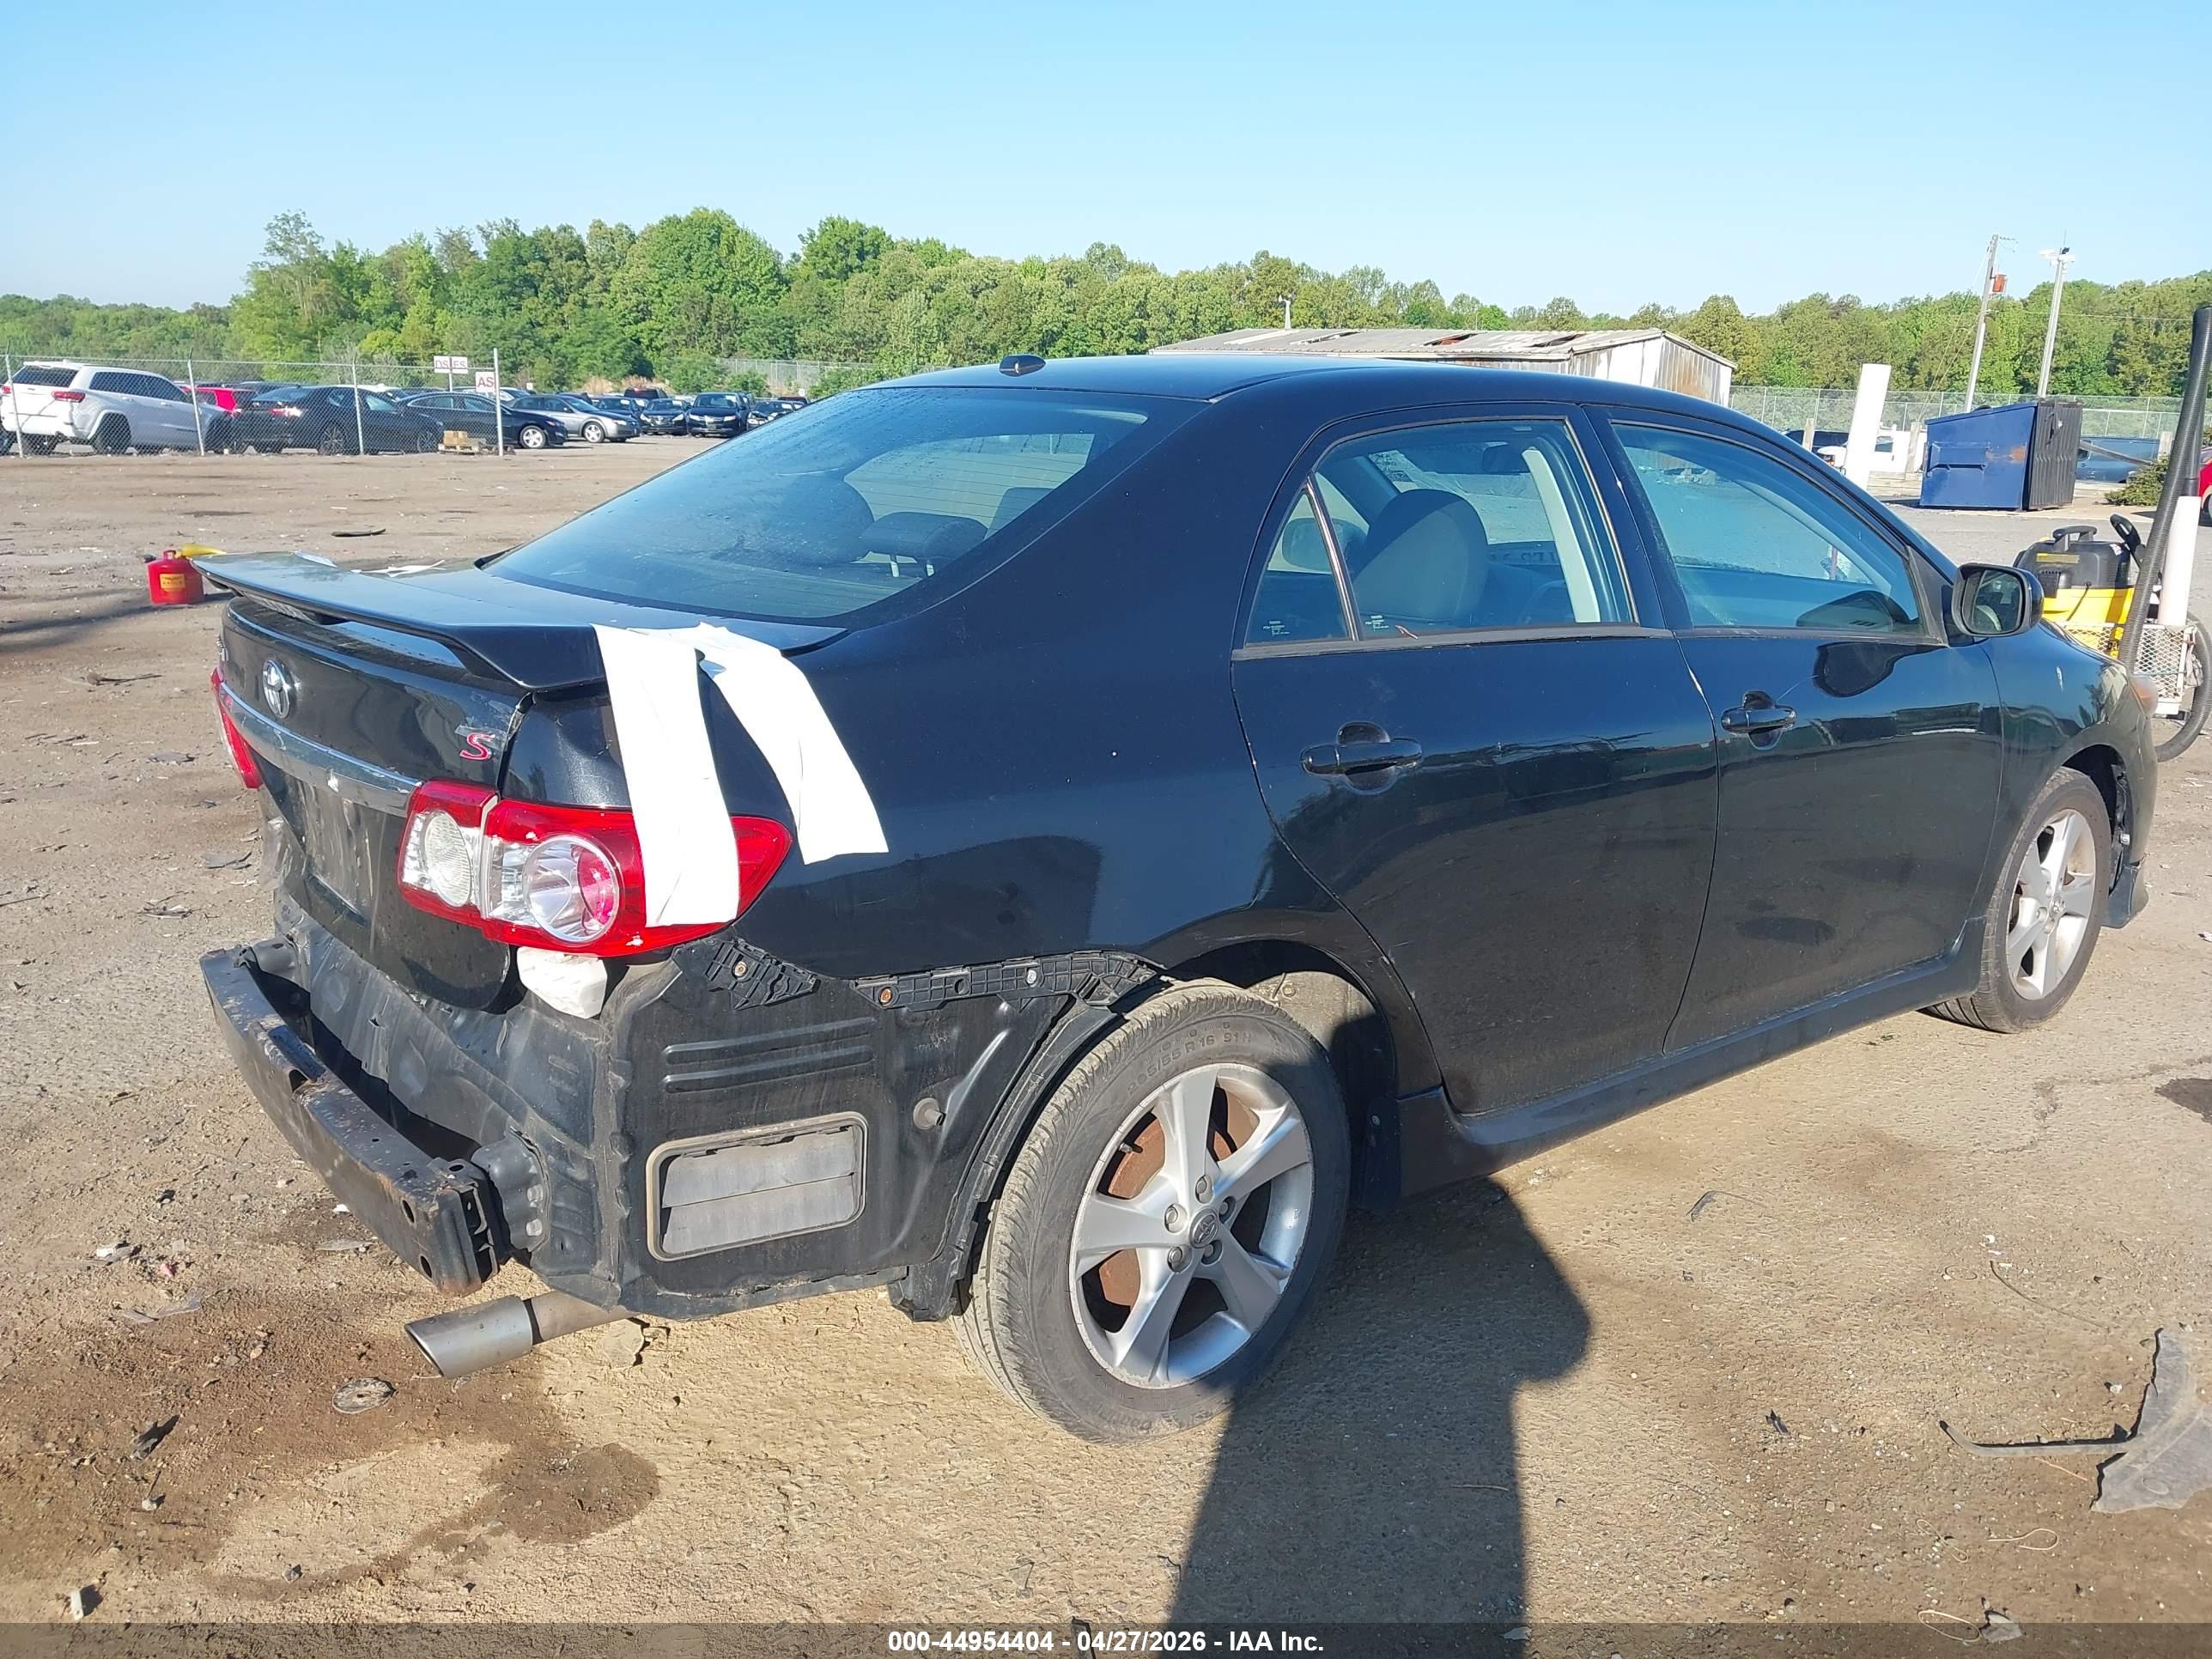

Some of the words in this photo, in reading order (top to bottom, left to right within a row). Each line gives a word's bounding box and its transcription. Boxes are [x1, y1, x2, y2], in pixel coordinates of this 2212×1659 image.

[477, 377, 495, 388] AS
[459, 732, 495, 761] S
[1184, 1040, 1196, 1054] R
[1199, 1034, 1215, 1048] 16
